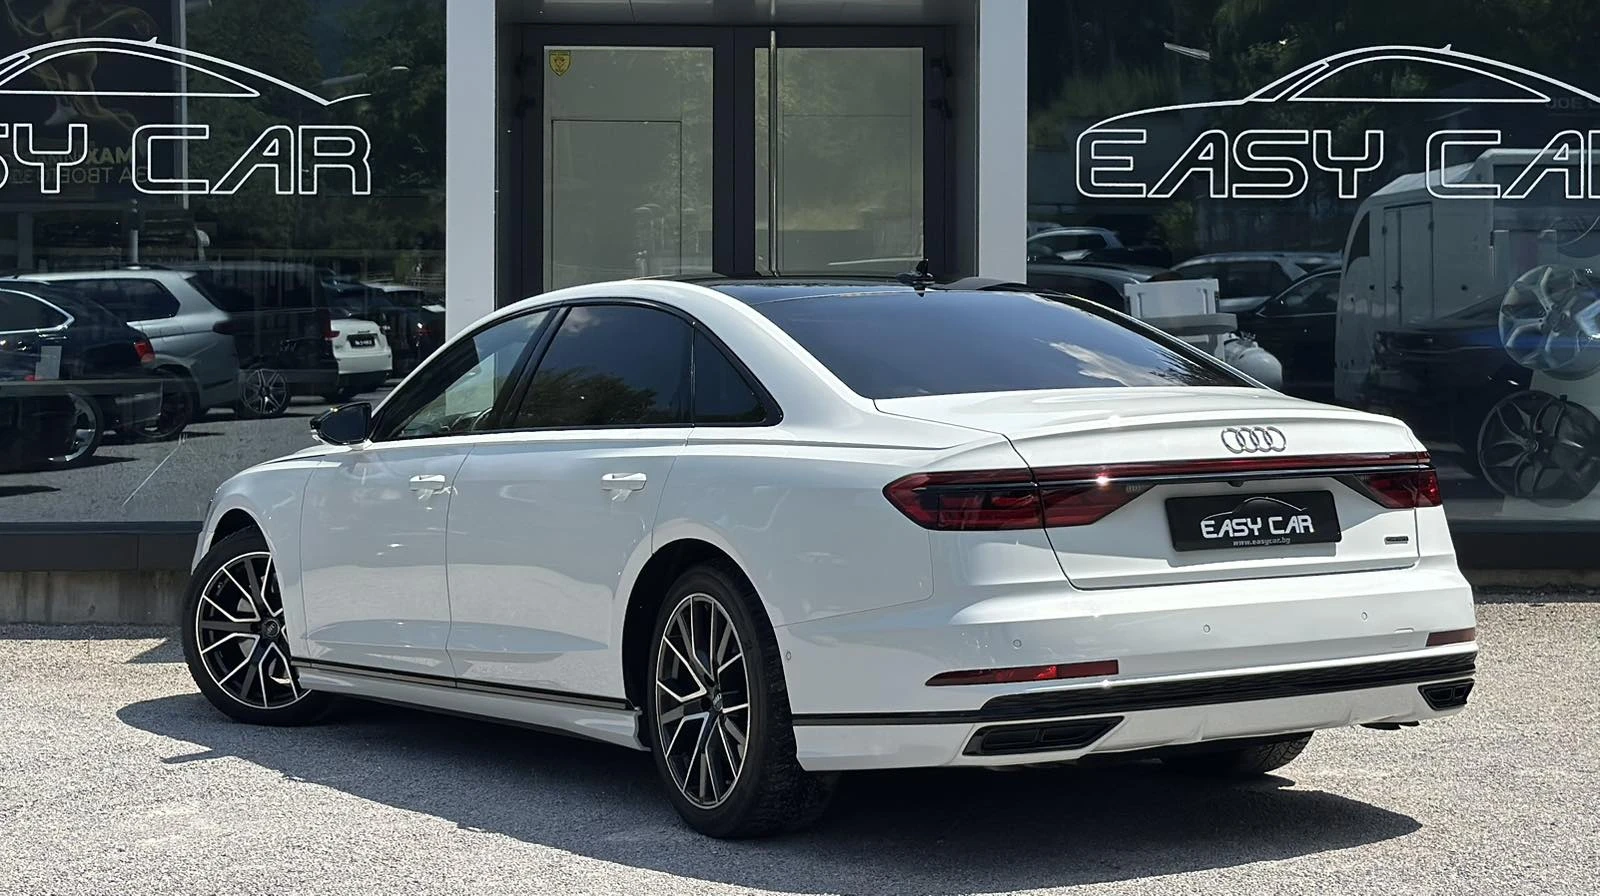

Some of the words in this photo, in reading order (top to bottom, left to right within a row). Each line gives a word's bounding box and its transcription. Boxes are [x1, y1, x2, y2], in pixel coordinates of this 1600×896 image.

[0, 123, 88, 194] Y
[132, 124, 371, 195] CAR
[1076, 129, 1384, 199] EASY
[1425, 129, 1600, 199] CA
[1200, 517, 1262, 539] EASY
[1268, 515, 1315, 535] CAR
[1233, 536, 1291, 547] www.easycar.bg
